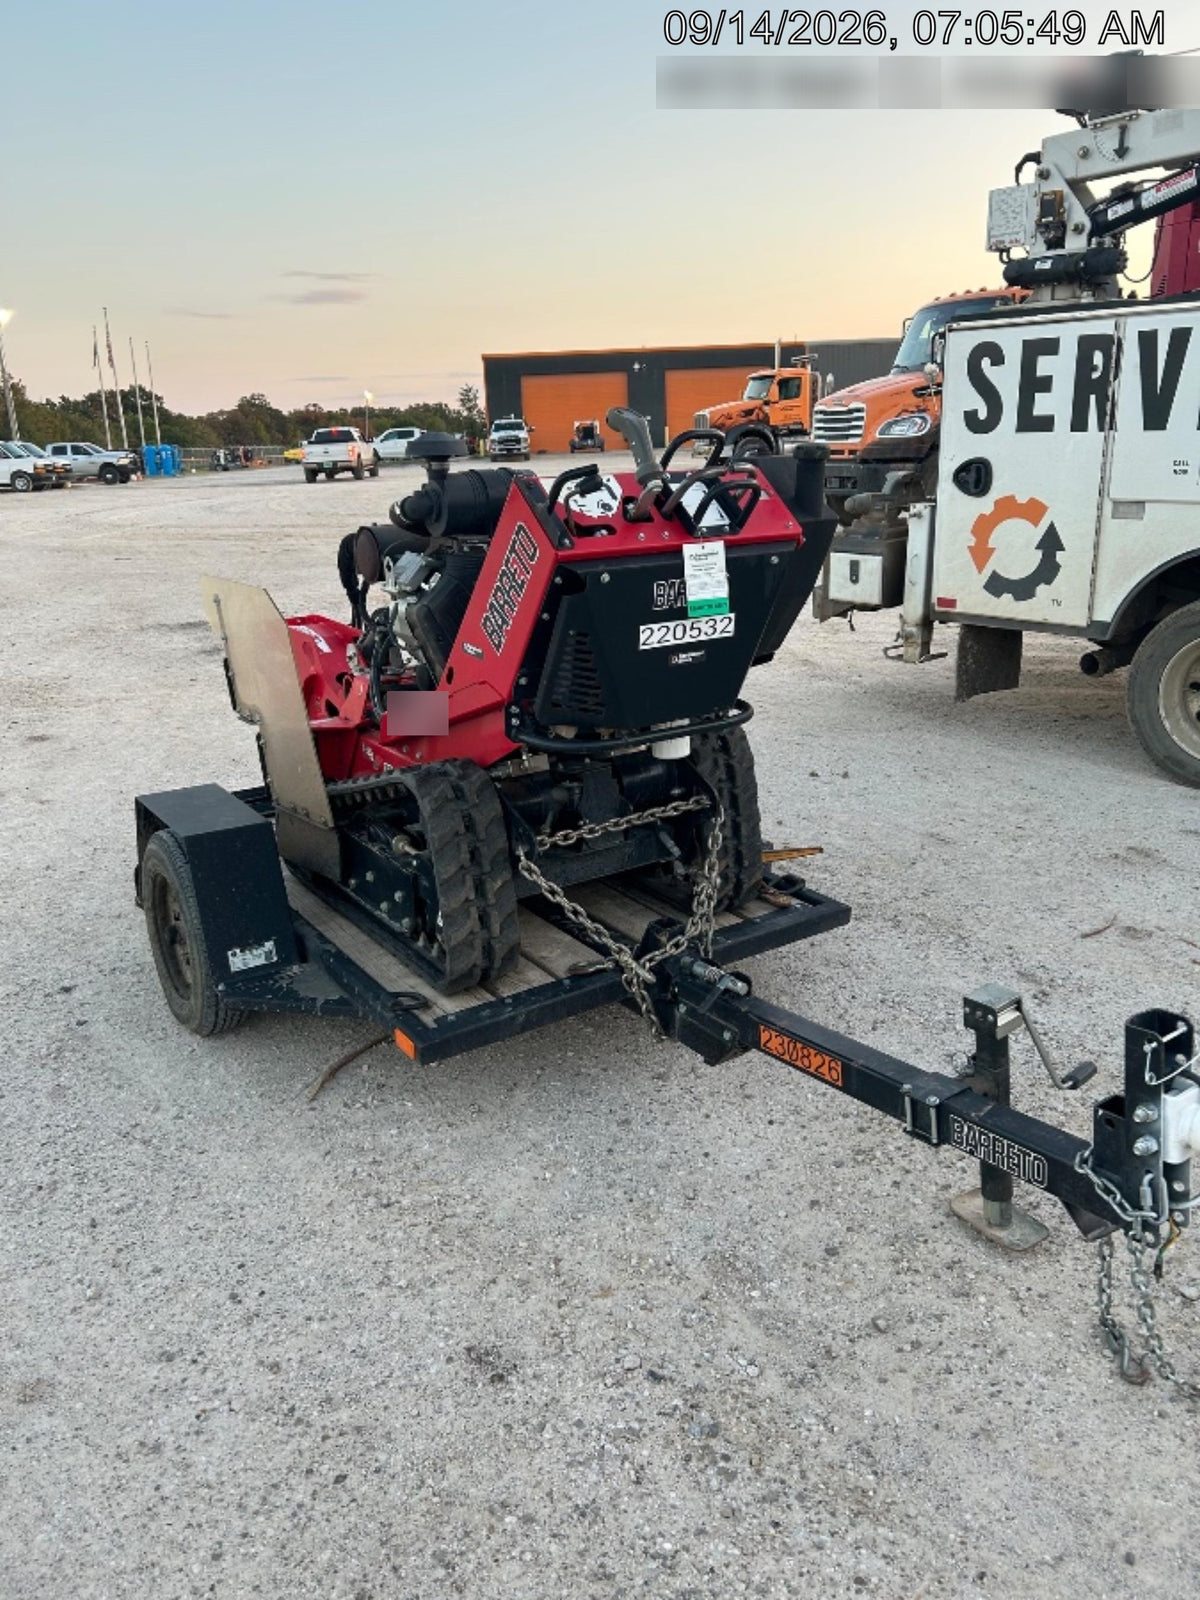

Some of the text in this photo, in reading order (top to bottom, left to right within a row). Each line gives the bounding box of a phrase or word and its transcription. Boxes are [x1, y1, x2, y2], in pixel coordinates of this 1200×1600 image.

[963, 327, 1200, 434] SERV
[481, 521, 540, 655] BARRETO
[653, 579, 688, 610] BAR
[641, 616, 733, 646] 220532
[762, 1027, 840, 1082] 230826
[949, 1114, 1048, 1188] BARRETO
